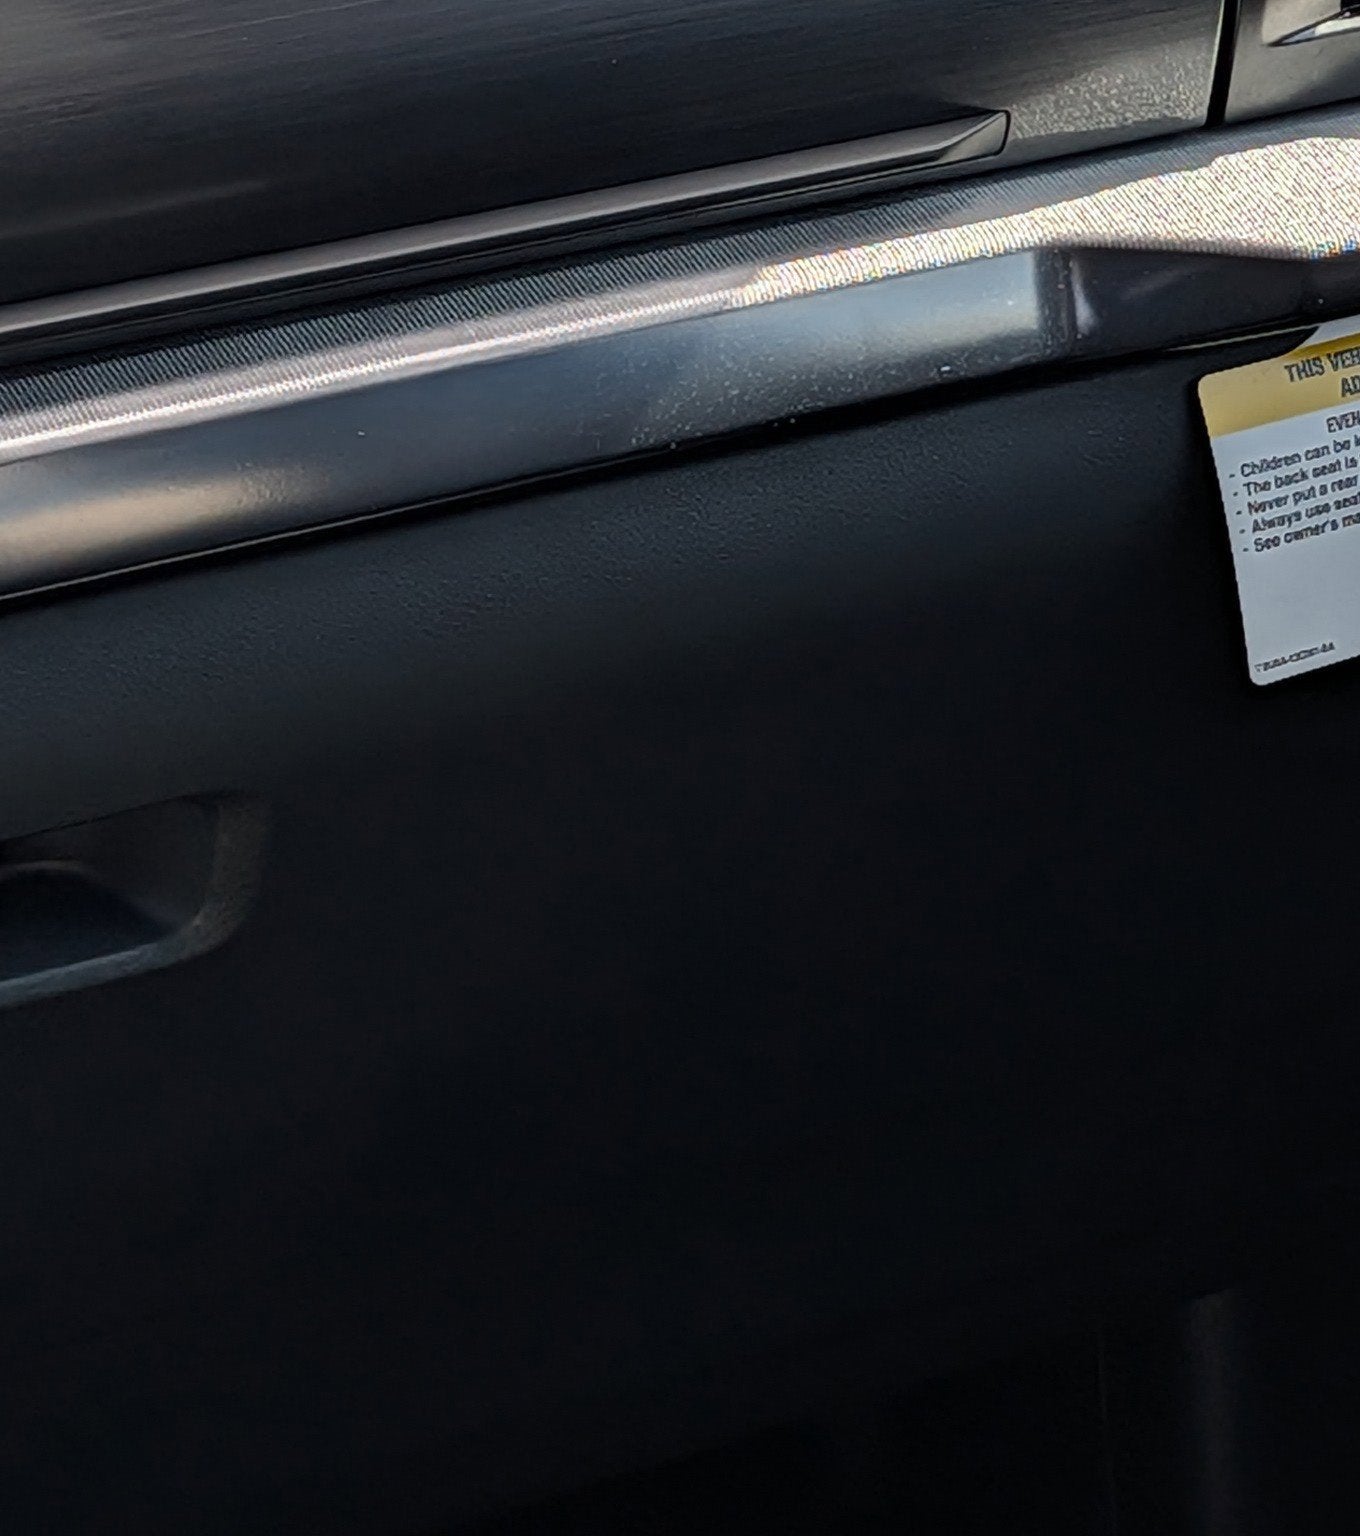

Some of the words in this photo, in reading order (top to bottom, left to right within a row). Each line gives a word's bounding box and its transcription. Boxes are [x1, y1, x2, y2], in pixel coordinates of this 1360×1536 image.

[1284, 355, 1325, 382] THIS
[1240, 452, 1302, 477] Children
[1303, 444, 1330, 461] can
[1332, 439, 1351, 453] be
[1242, 480, 1271, 497] The
[1273, 467, 1308, 489] back
[1311, 458, 1342, 478] seat
[1344, 456, 1358, 470] is
[1246, 494, 1289, 515] Never
[1291, 485, 1317, 506] put
[1318, 483, 1329, 496] a
[1330, 474, 1358, 493] rear
[1251, 510, 1302, 533] Always
[1304, 502, 1331, 519] use
[1253, 535, 1281, 552] See
[1283, 518, 1339, 544] owner's
